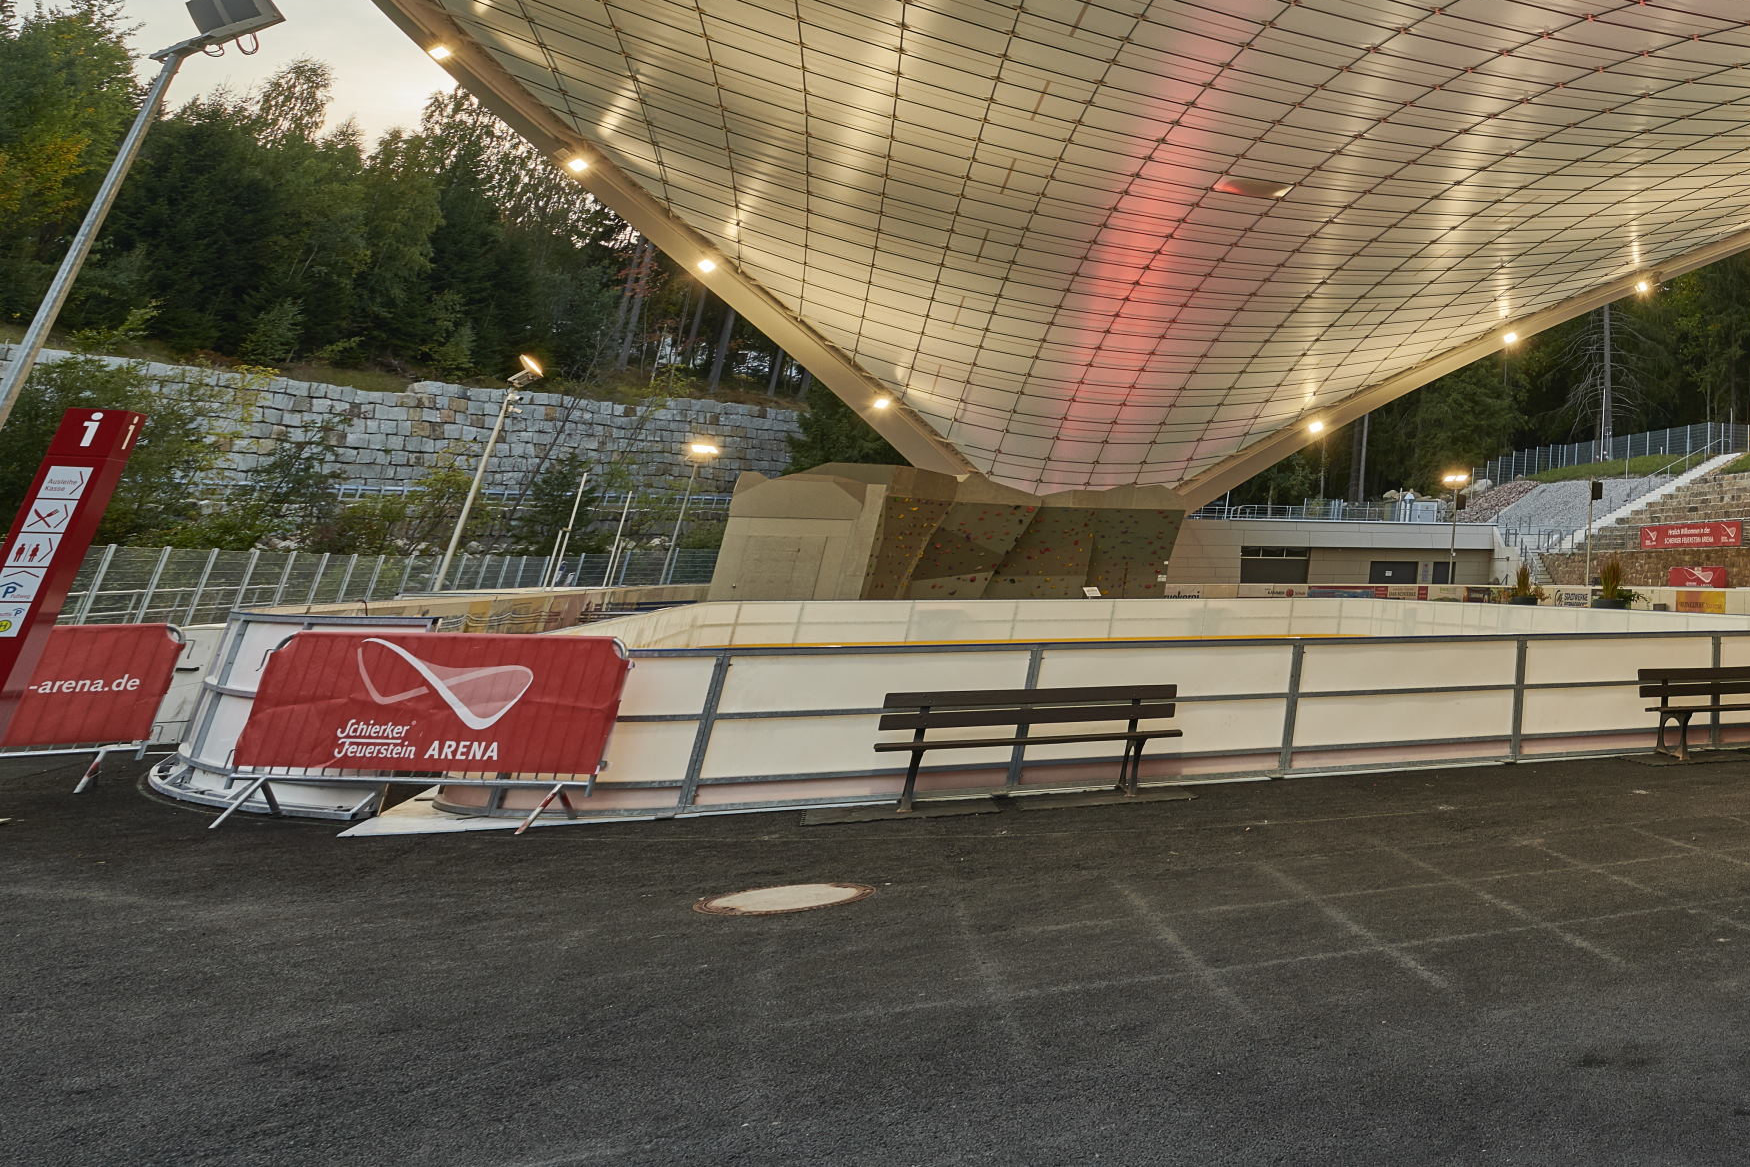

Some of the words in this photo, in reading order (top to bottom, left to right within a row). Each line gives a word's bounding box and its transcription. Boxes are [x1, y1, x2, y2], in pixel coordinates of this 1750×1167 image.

[28, 674, 141, 694] -arena.de
[336, 719, 411, 739] Schierker
[423, 740, 499, 761] ARENA
